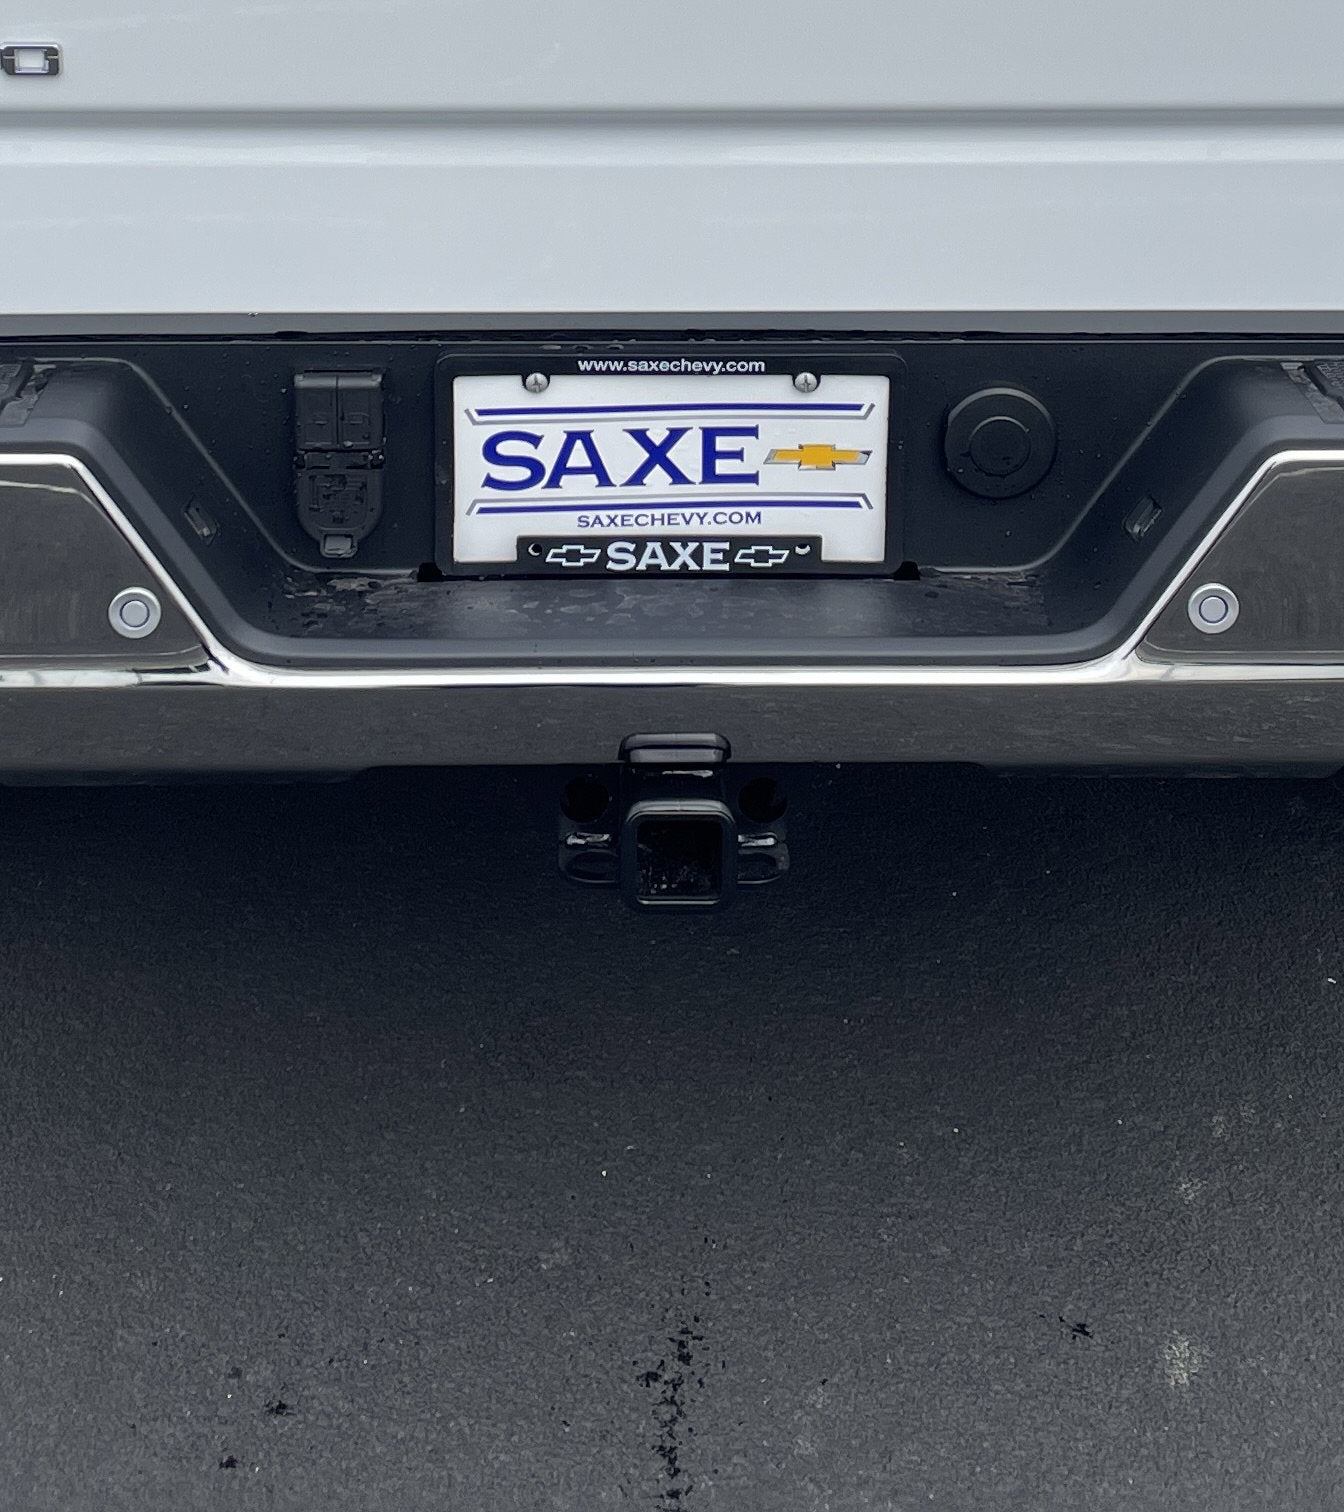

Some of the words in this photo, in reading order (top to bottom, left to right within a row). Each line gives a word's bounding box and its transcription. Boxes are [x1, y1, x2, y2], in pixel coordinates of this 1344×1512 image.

[577, 358, 766, 375] www.saxechevy.com
[481, 424, 760, 491] SAXE
[576, 511, 763, 529] SAXECHEVY.COM
[605, 541, 731, 572] SAXE
